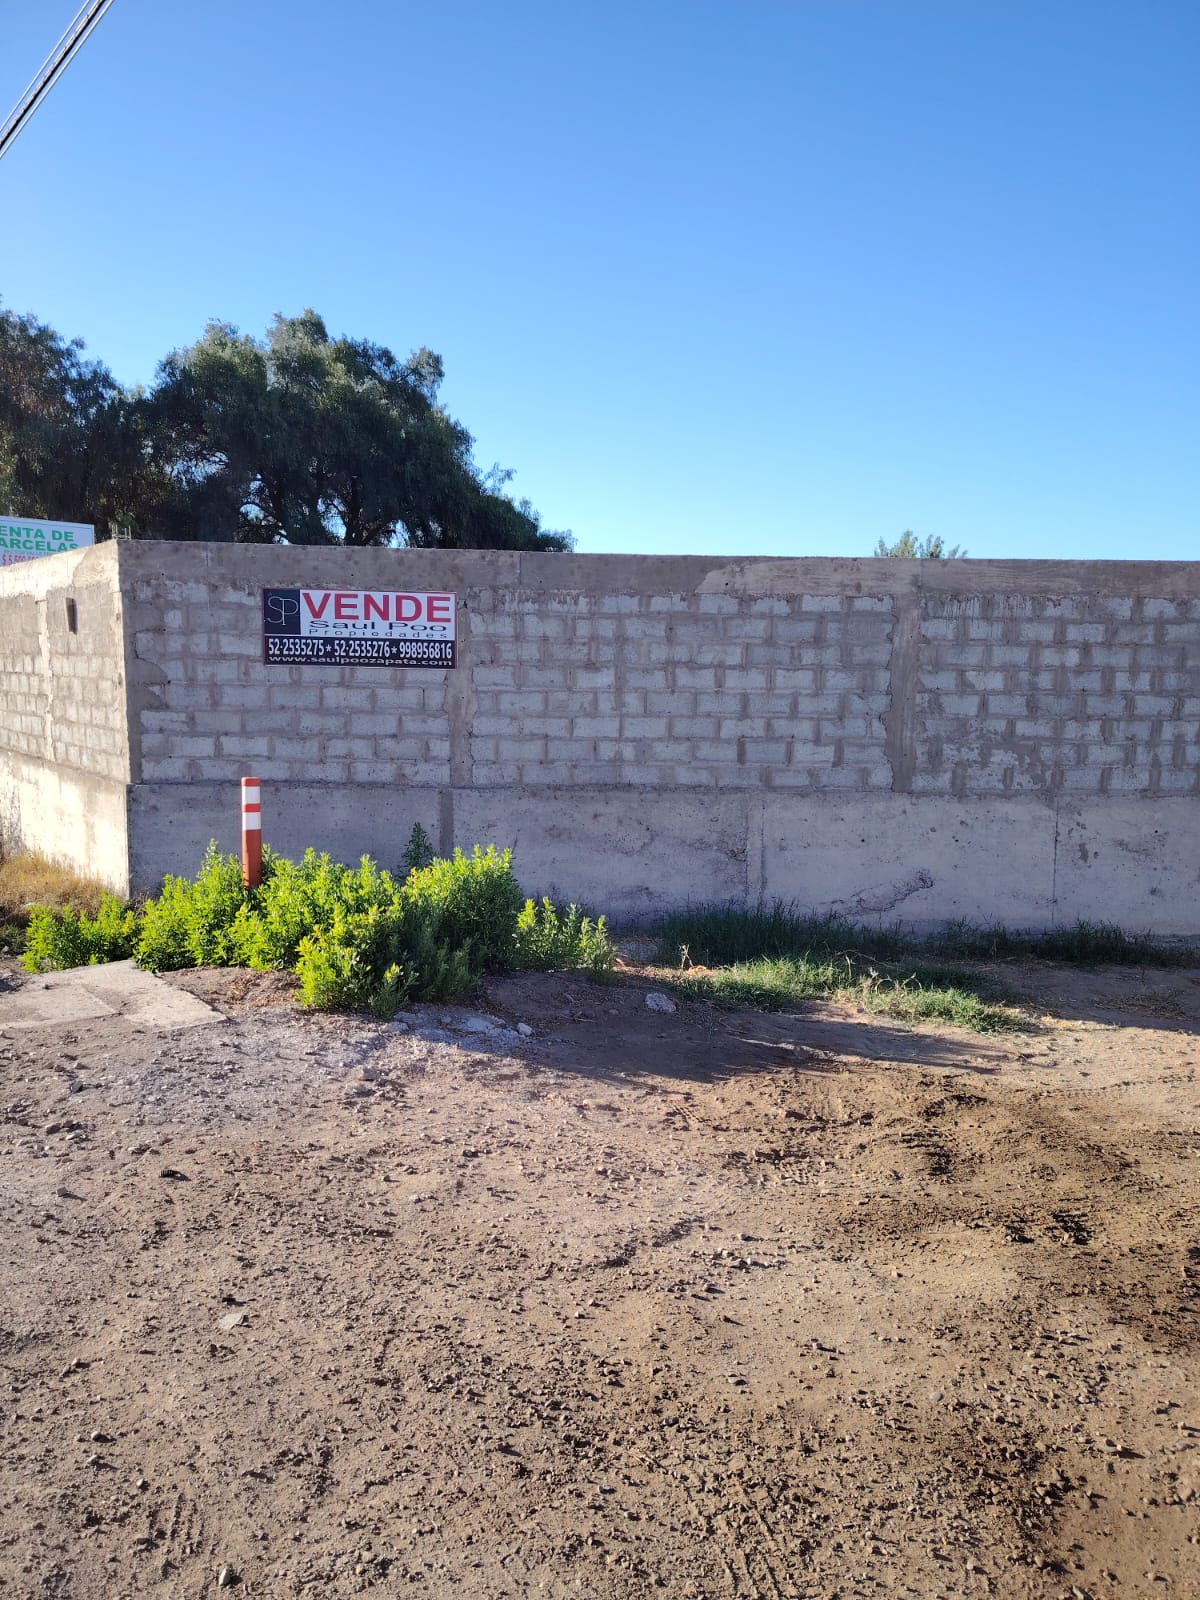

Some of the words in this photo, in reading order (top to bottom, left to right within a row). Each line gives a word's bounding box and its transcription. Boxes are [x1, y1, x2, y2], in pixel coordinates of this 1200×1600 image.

[52, 530, 74, 541] DE
[302, 592, 451, 623] VENDE
[309, 620, 375, 630] Saul
[389, 622, 446, 632] Poo
[309, 629, 447, 638] Propiedades
[399, 641, 452, 659] 998956816
[269, 656, 452, 666] www.saulpoozapata.com
